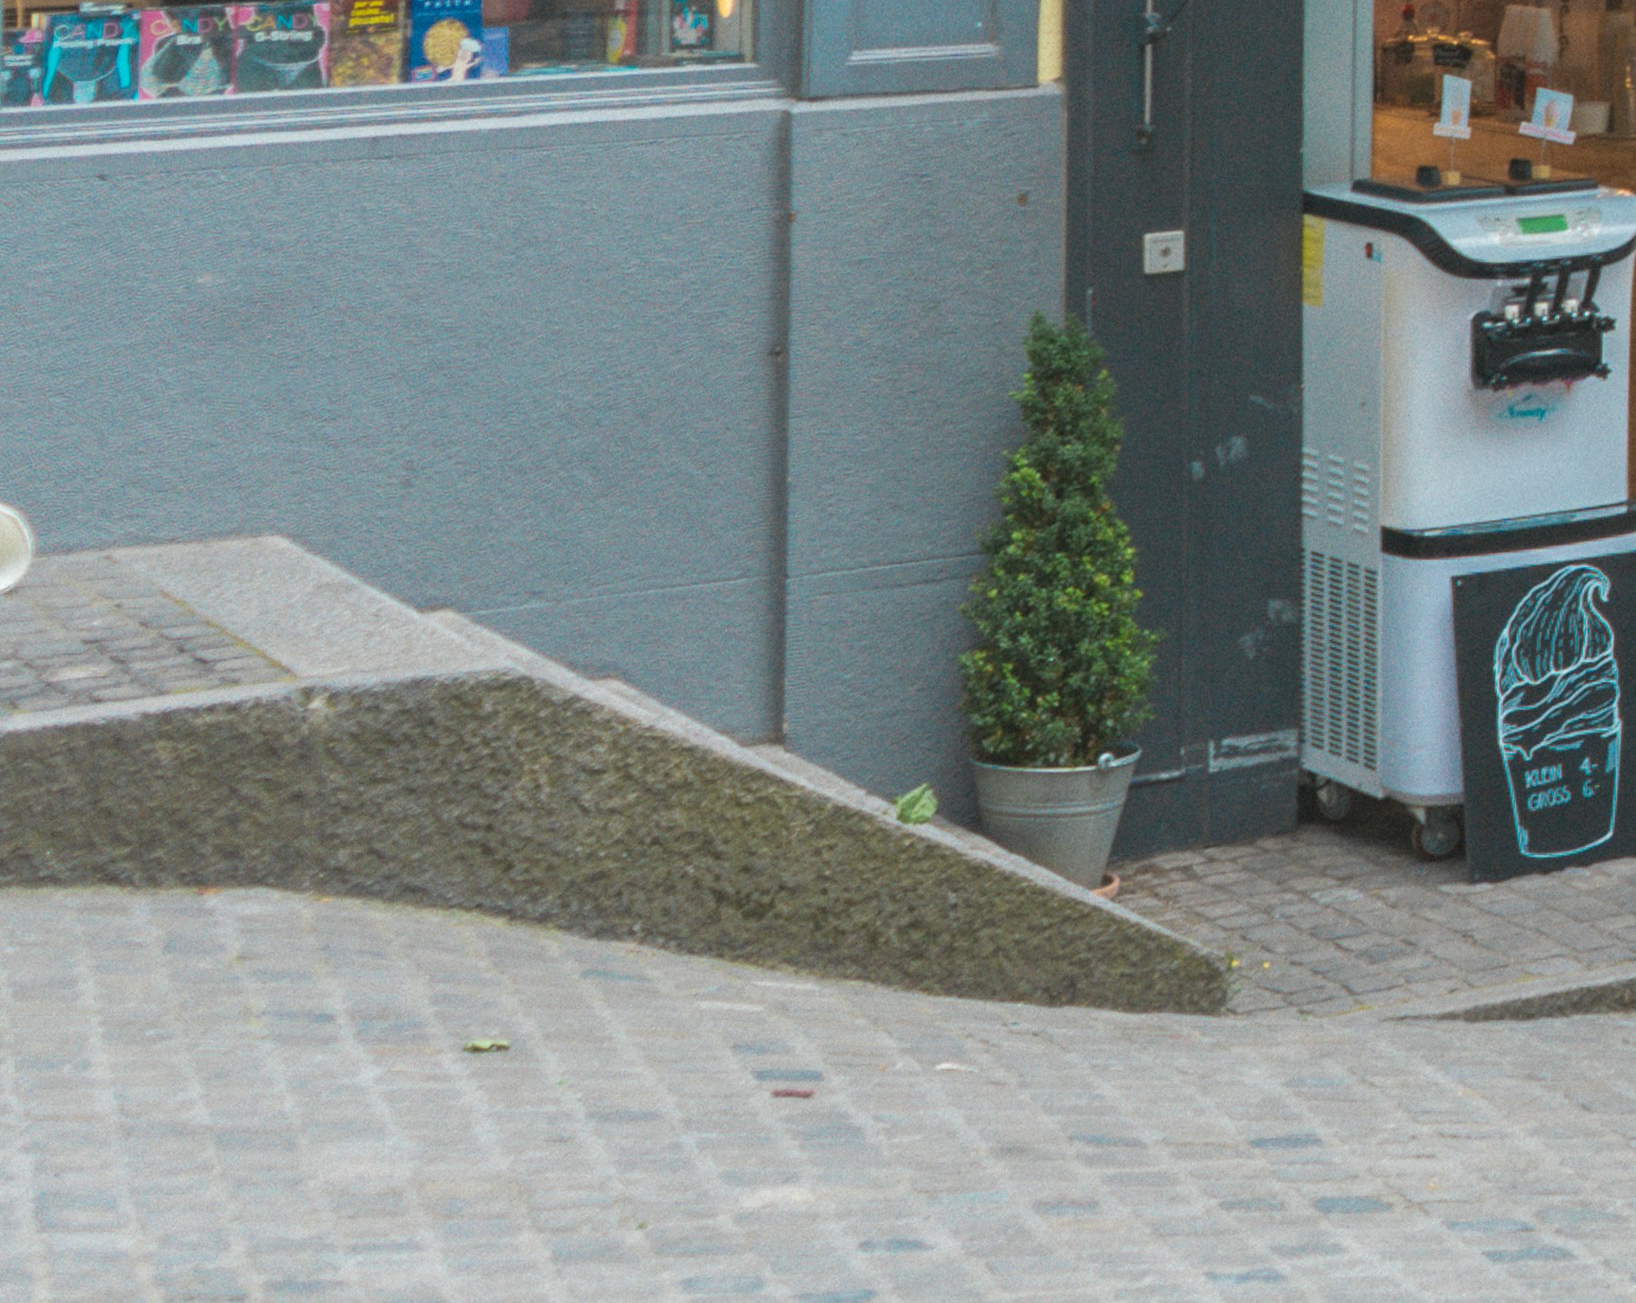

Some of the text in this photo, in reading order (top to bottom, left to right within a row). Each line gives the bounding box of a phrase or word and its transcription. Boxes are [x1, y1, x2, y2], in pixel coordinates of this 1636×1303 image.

[150, 16, 229, 36] CANDY
[1524, 764, 1563, 789] KLEIN
[1527, 785, 1571, 811] GROSS
